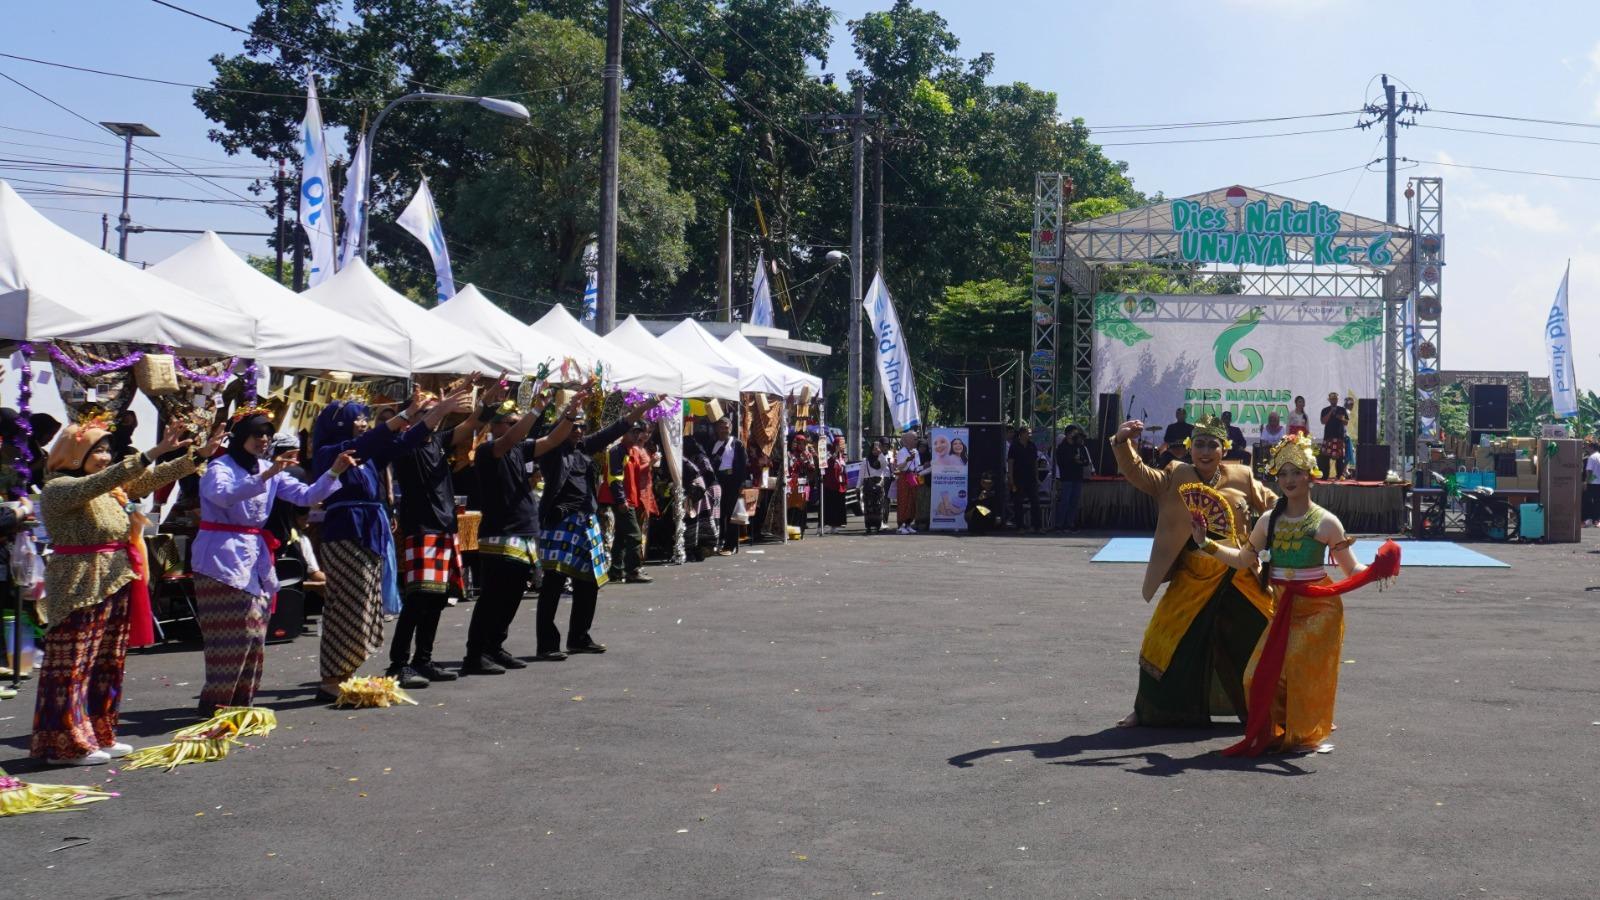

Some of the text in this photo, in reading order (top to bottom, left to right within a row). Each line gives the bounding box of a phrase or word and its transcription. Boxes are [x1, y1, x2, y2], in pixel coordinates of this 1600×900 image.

[1172, 199, 1341, 235] Dies Natalis
[1181, 230, 1288, 266] UNJAYA
[1184, 388, 1292, 402] DIES NATALIS
